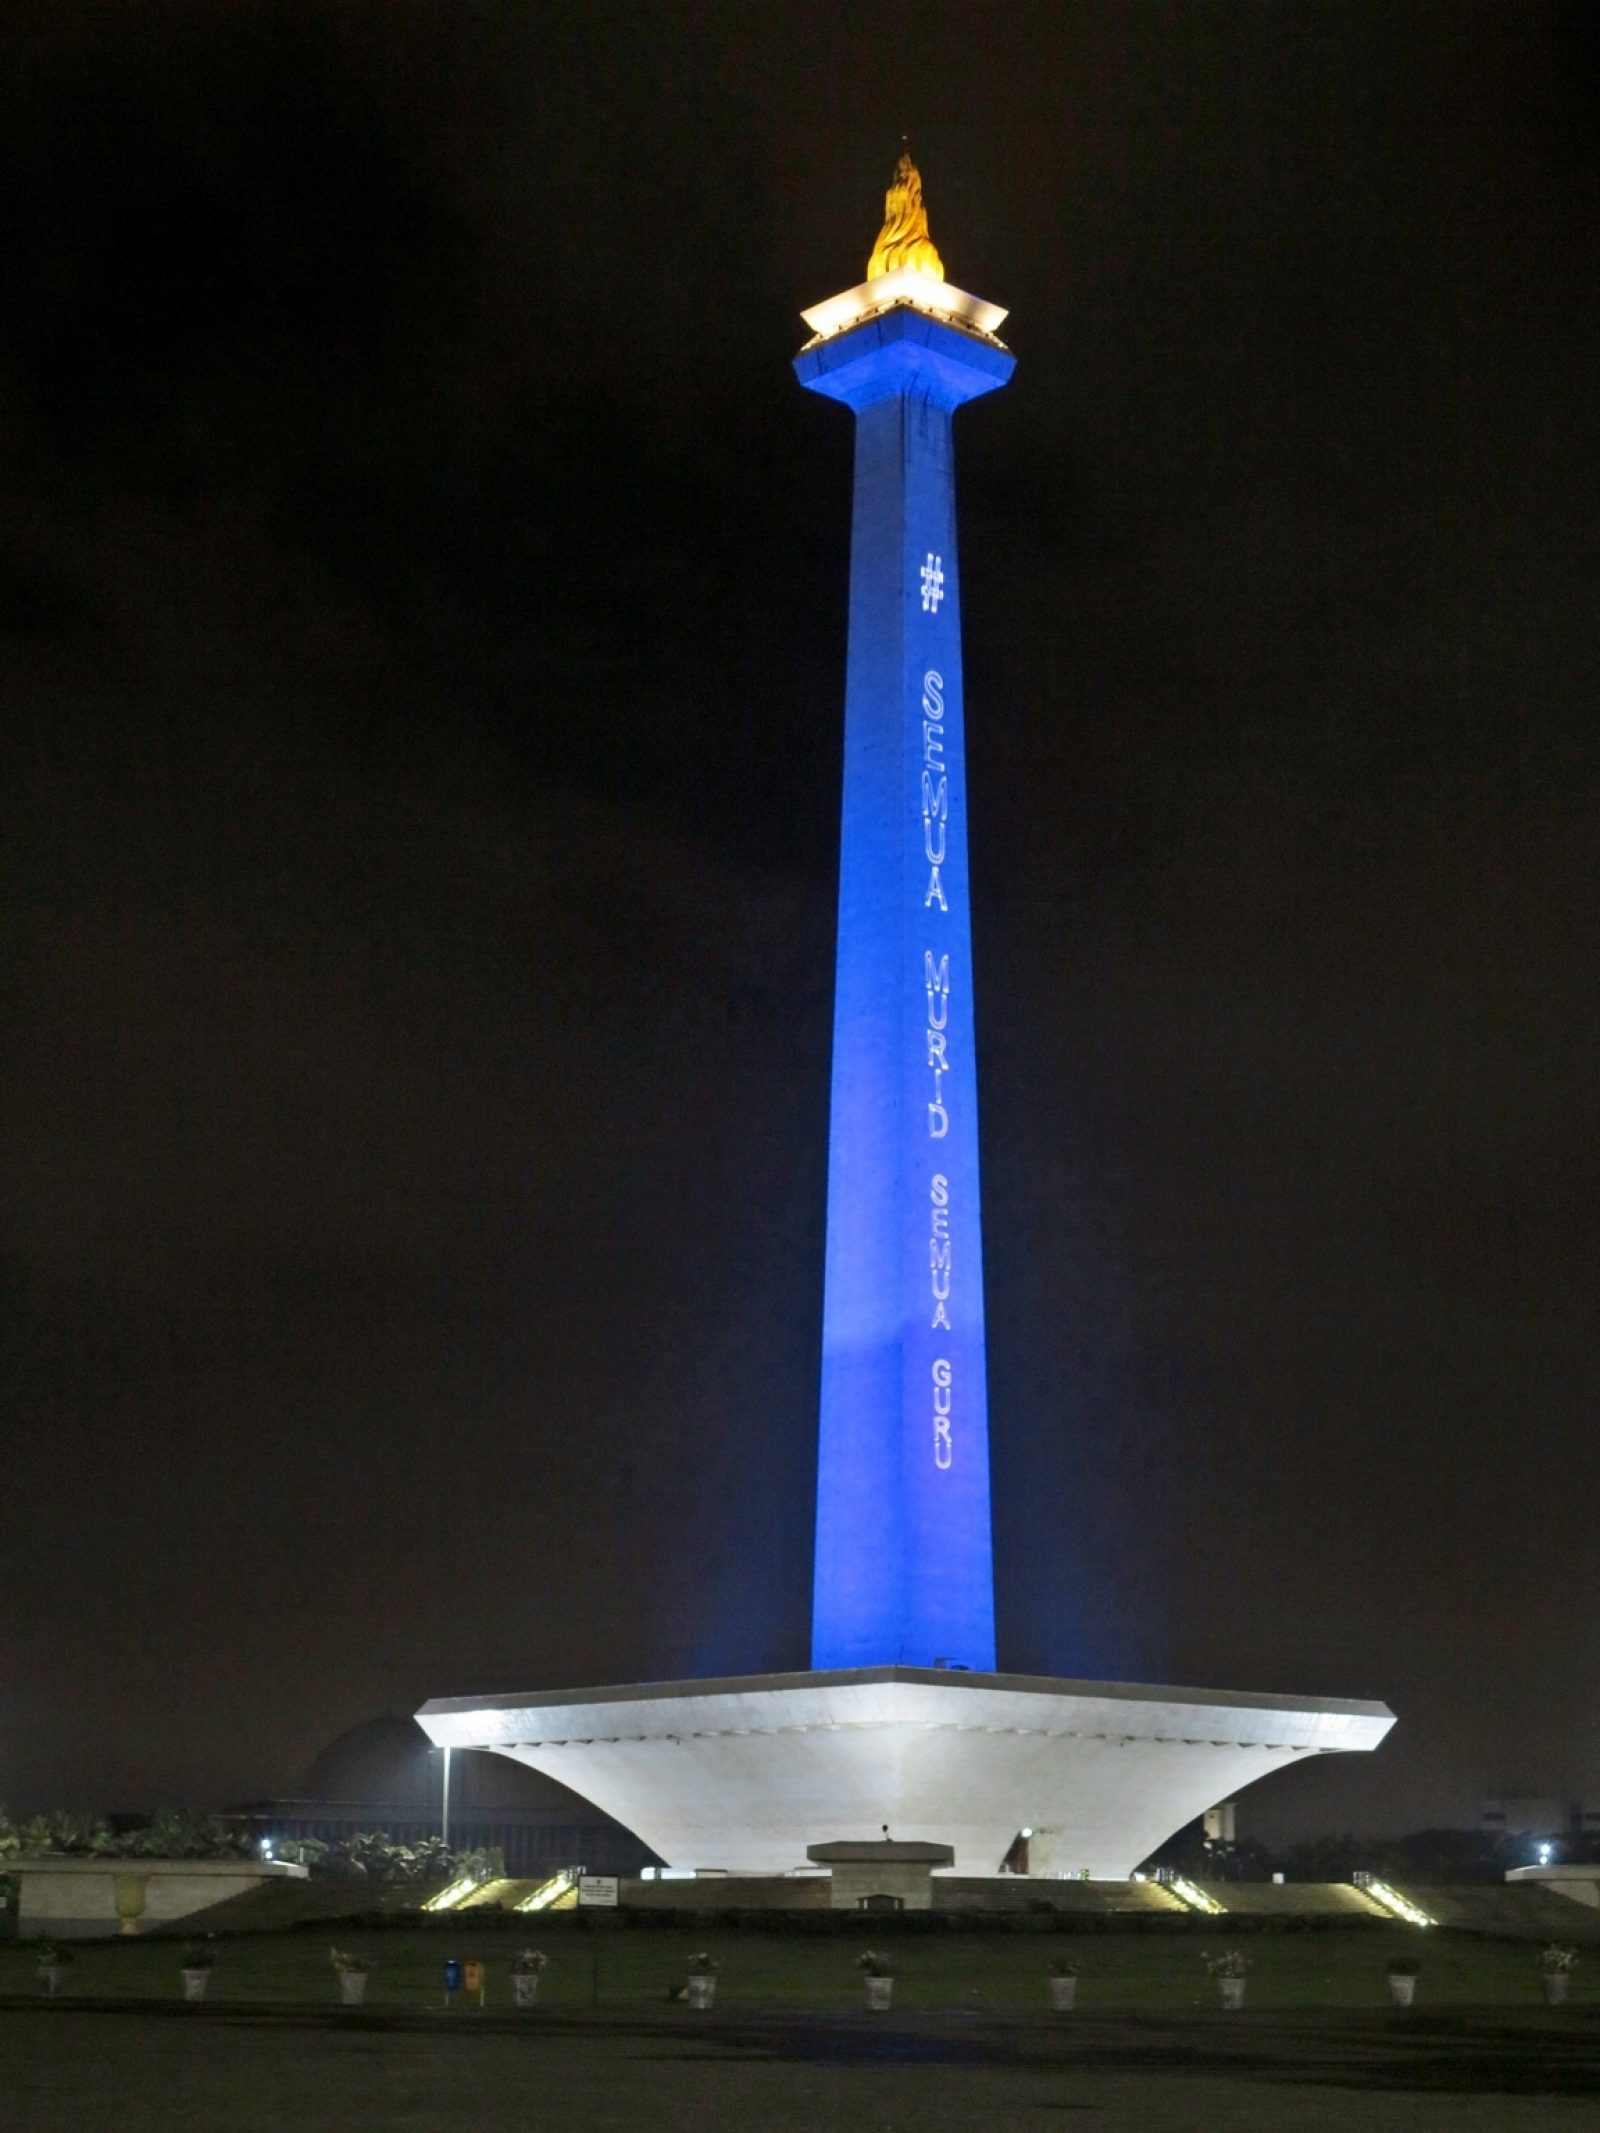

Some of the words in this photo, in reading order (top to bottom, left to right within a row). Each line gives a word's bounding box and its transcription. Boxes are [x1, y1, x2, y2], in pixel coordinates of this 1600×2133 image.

[921, 670, 948, 912] SEMUA
[924, 950, 950, 1138] MURID
[929, 1173, 951, 1331] SEMUA
[931, 1358, 952, 1470] GURU
